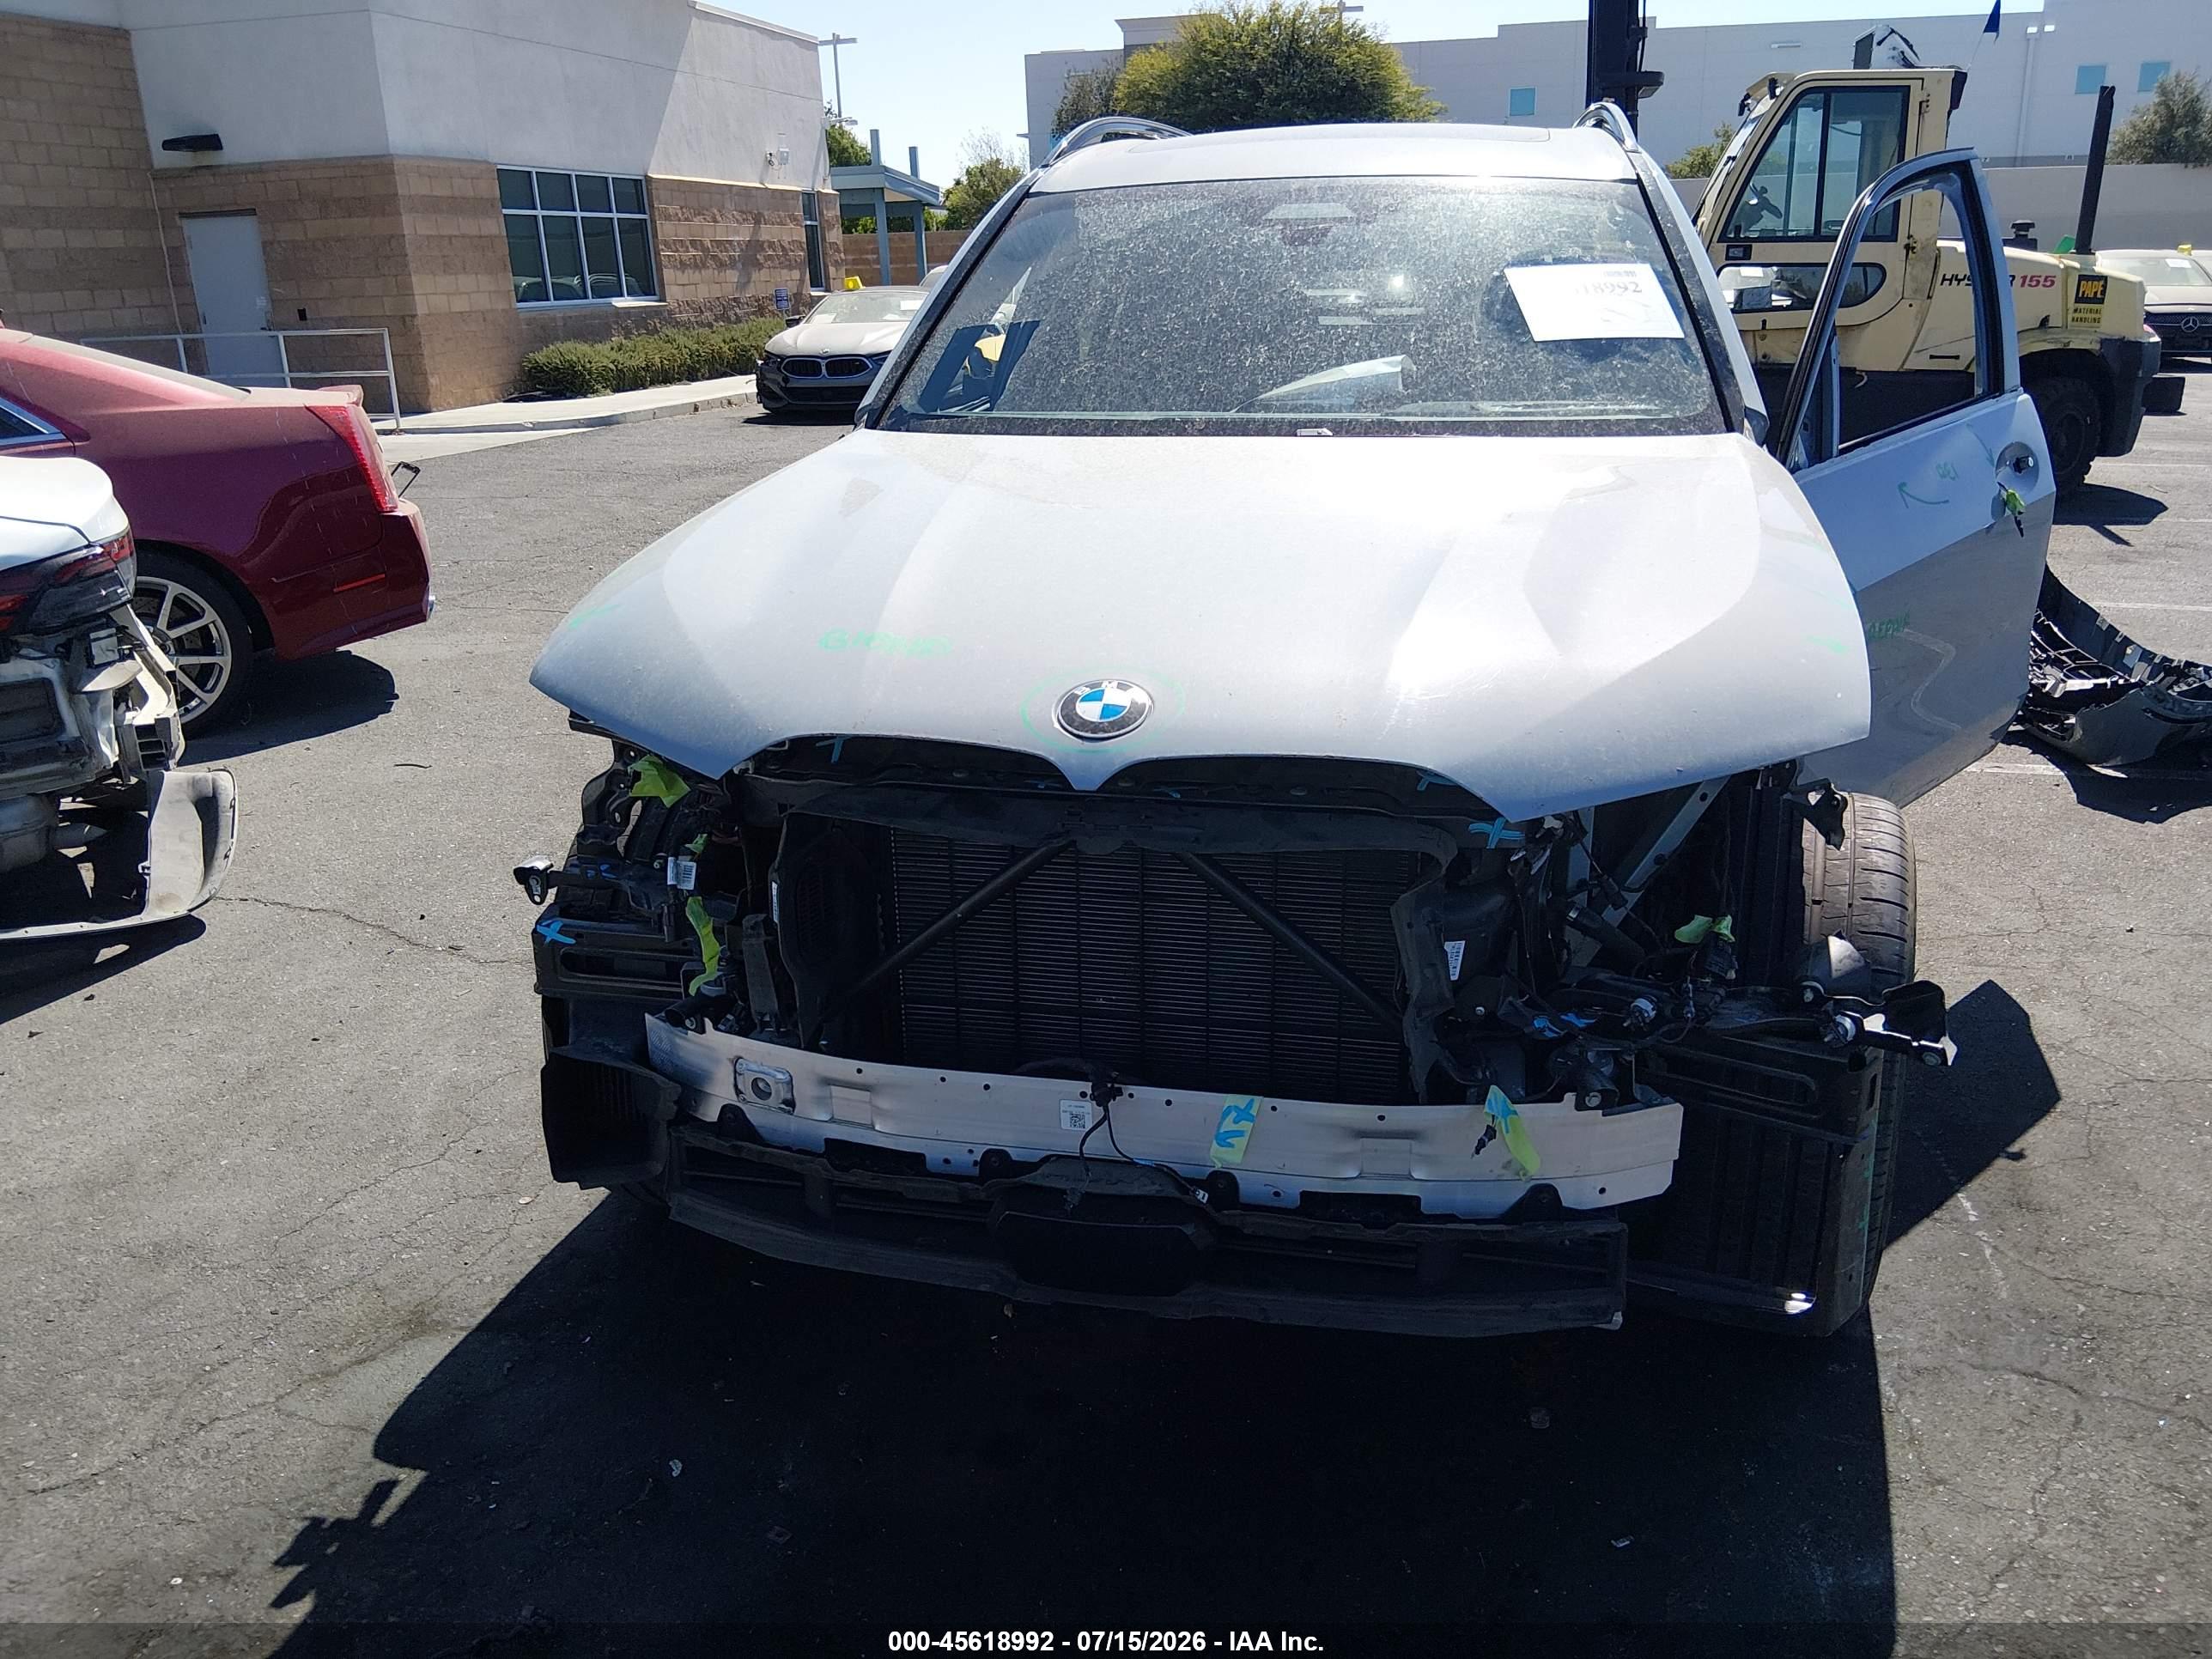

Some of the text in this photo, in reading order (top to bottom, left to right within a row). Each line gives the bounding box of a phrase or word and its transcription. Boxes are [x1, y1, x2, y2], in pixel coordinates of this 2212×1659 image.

[2020, 275, 2057, 289] 155
[2073, 307, 2102, 315] MATERIAL
[2071, 315, 2102, 324] HANDLING
